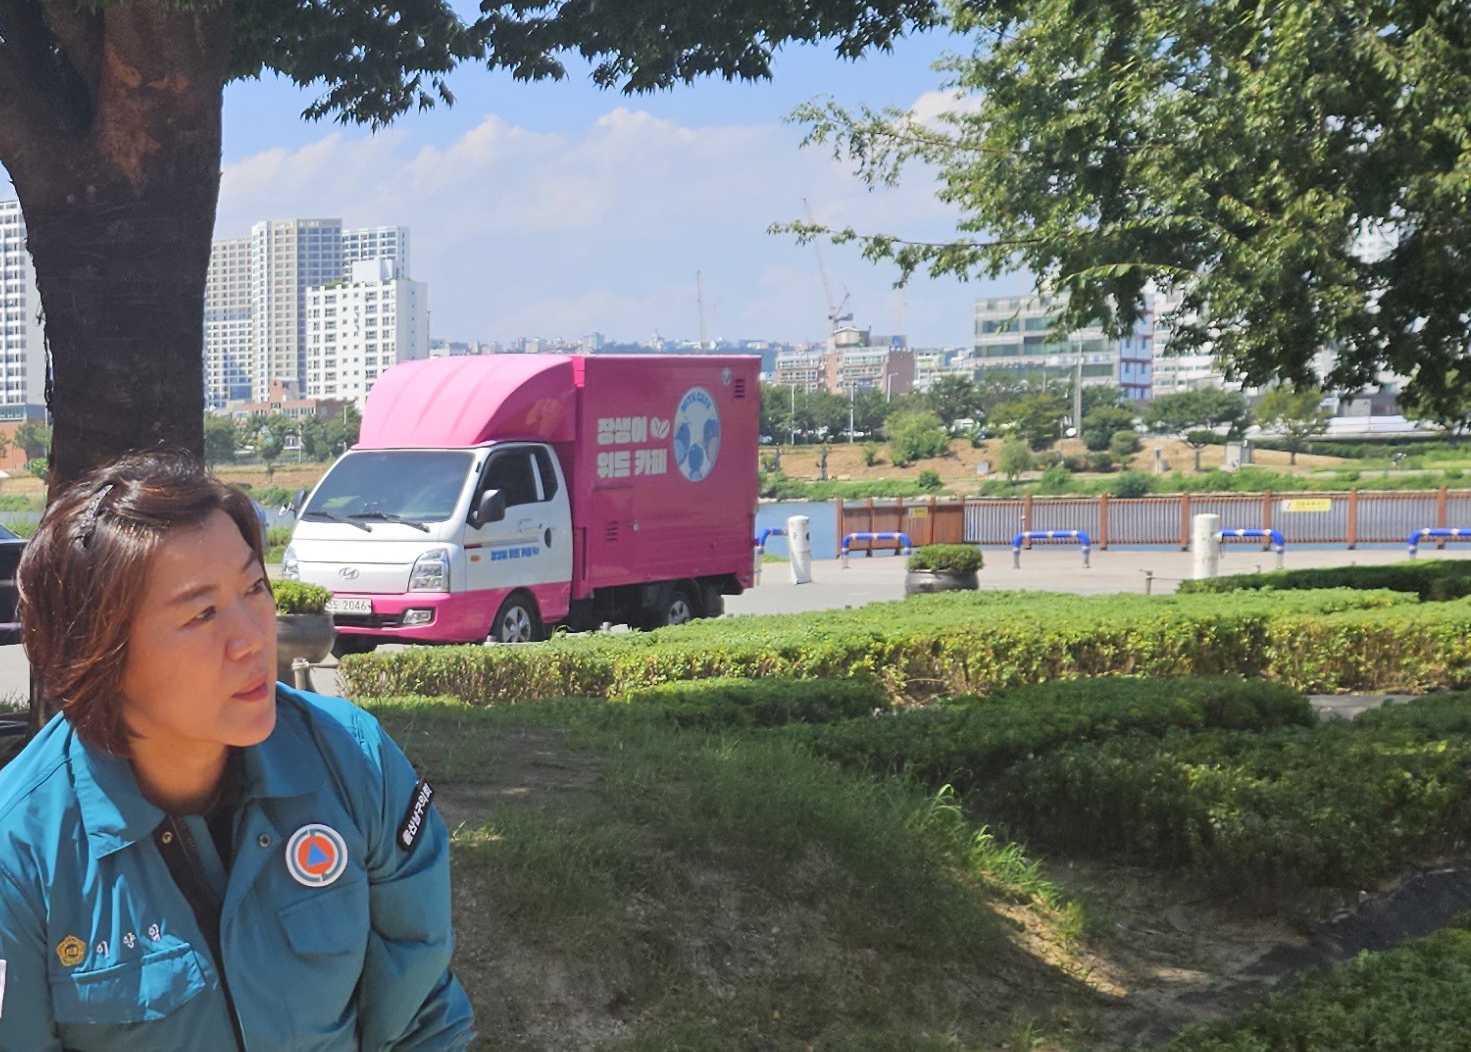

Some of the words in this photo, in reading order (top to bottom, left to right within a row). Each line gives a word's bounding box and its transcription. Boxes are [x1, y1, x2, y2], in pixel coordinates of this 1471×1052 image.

[597, 416, 648, 445] 장생이
[597, 450, 631, 478] 위드
[634, 448, 667, 476] 카페
[343, 600, 367, 610] 2046
